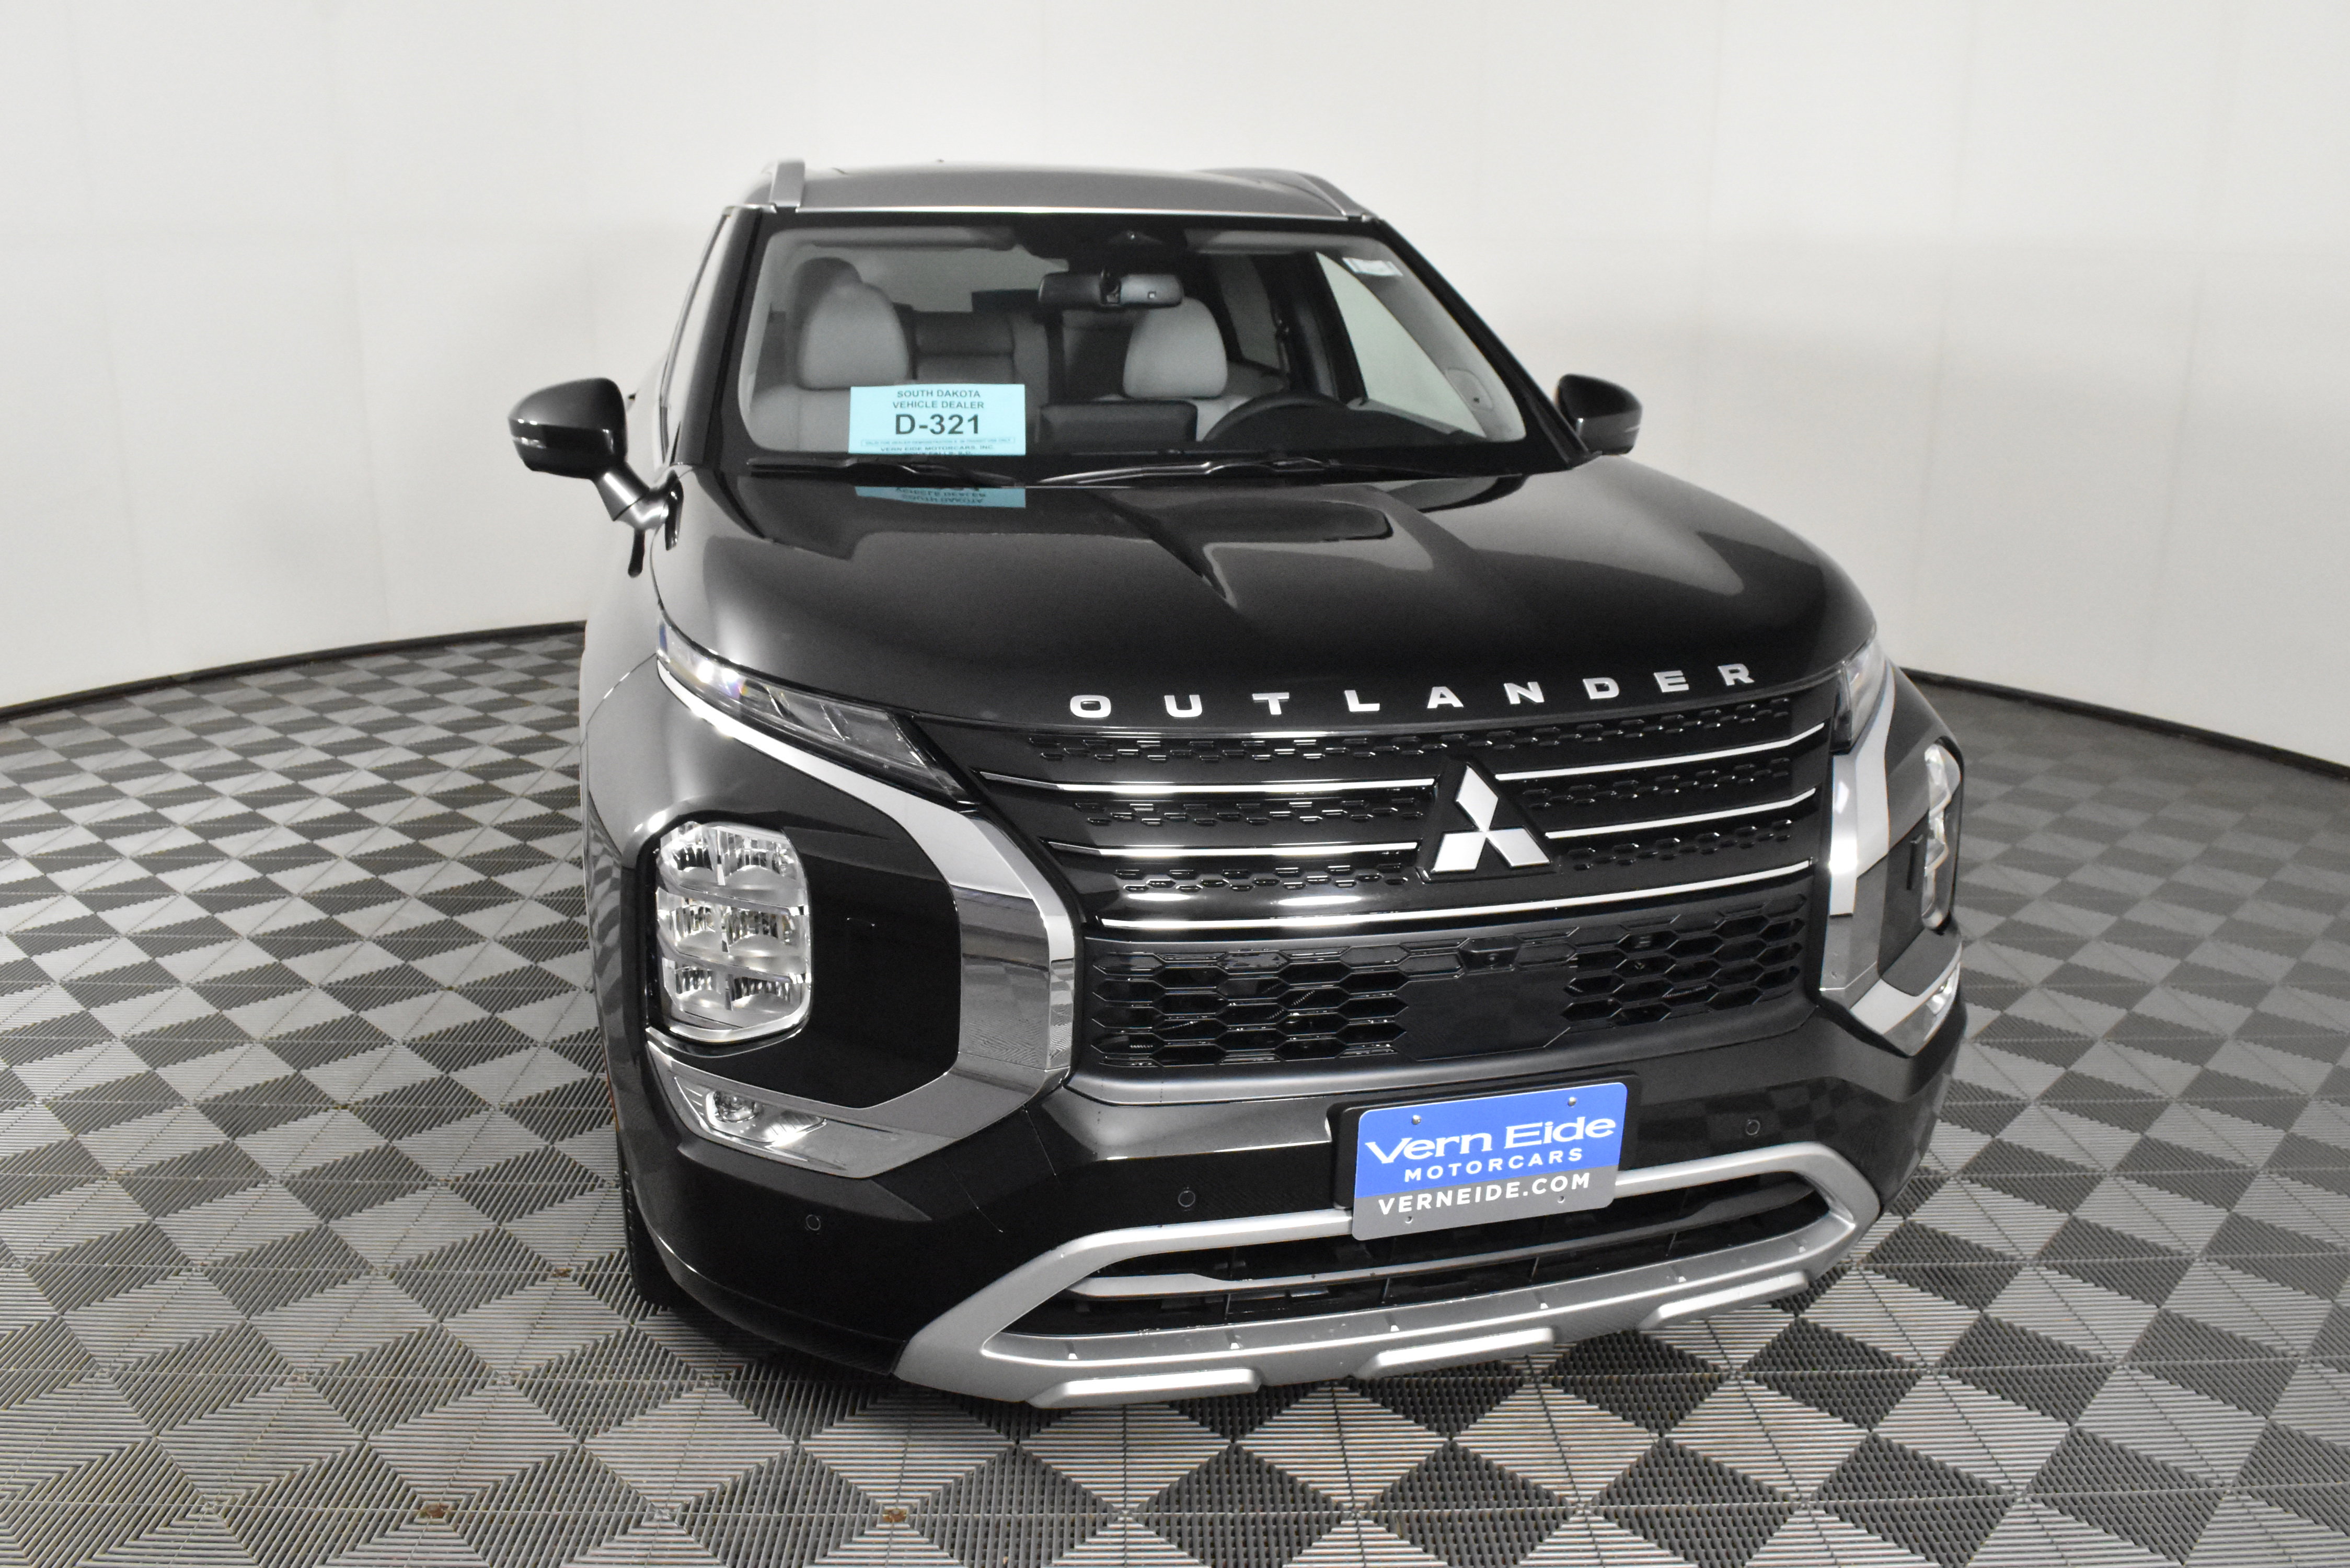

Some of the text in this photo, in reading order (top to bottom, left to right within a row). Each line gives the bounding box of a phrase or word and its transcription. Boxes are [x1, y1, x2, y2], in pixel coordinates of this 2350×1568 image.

[897, 389, 981, 398] SOUTH DAKOTA
[895, 413, 978, 435] D-321
[1069, 662, 1755, 719] OUTLANDER
[1365, 1116, 1616, 1164] Vern Eide
[1403, 1148, 1583, 1182] MOTORCARS
[1378, 1172, 1590, 1215] VERNEIDE.COM
